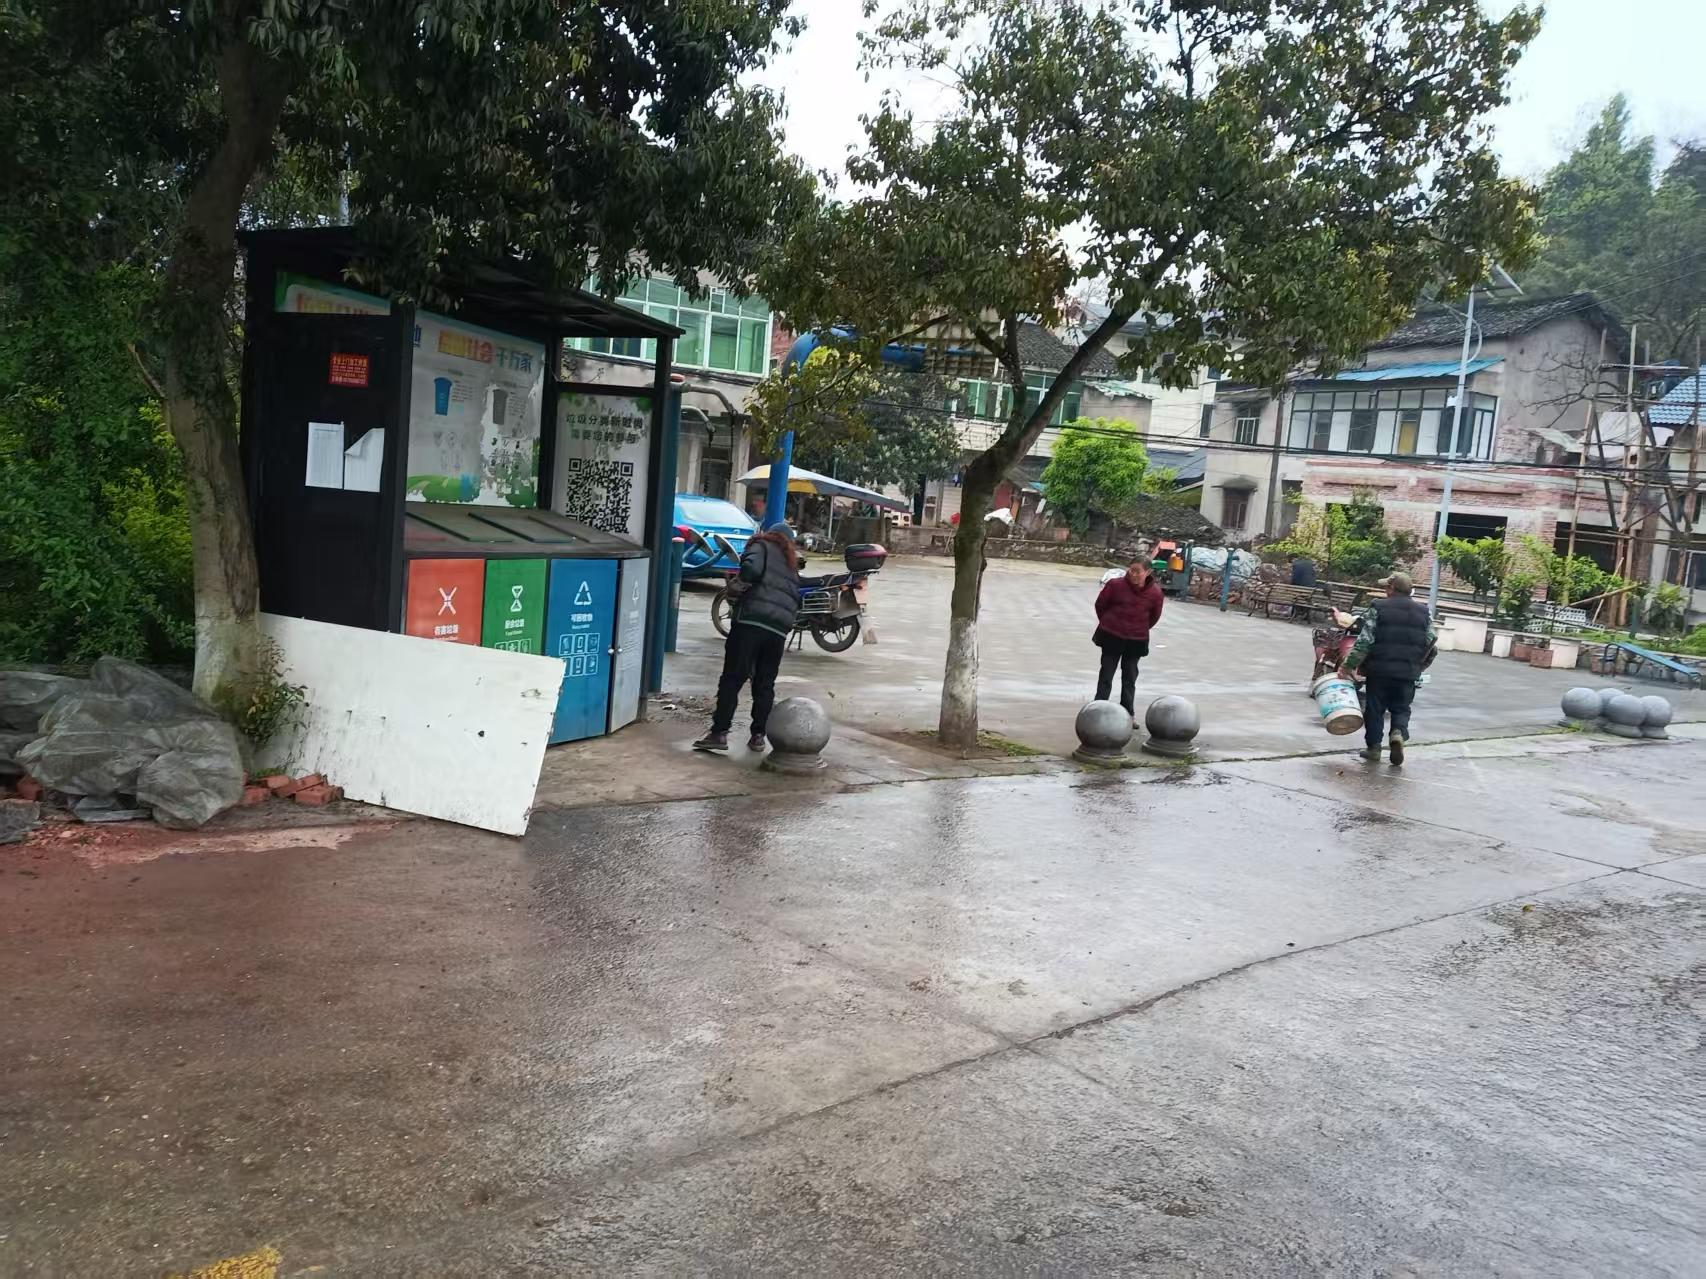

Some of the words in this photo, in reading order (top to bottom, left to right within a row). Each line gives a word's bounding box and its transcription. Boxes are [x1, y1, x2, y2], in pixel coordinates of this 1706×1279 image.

[566, 414, 643, 429] 垃圾分类新时尚
